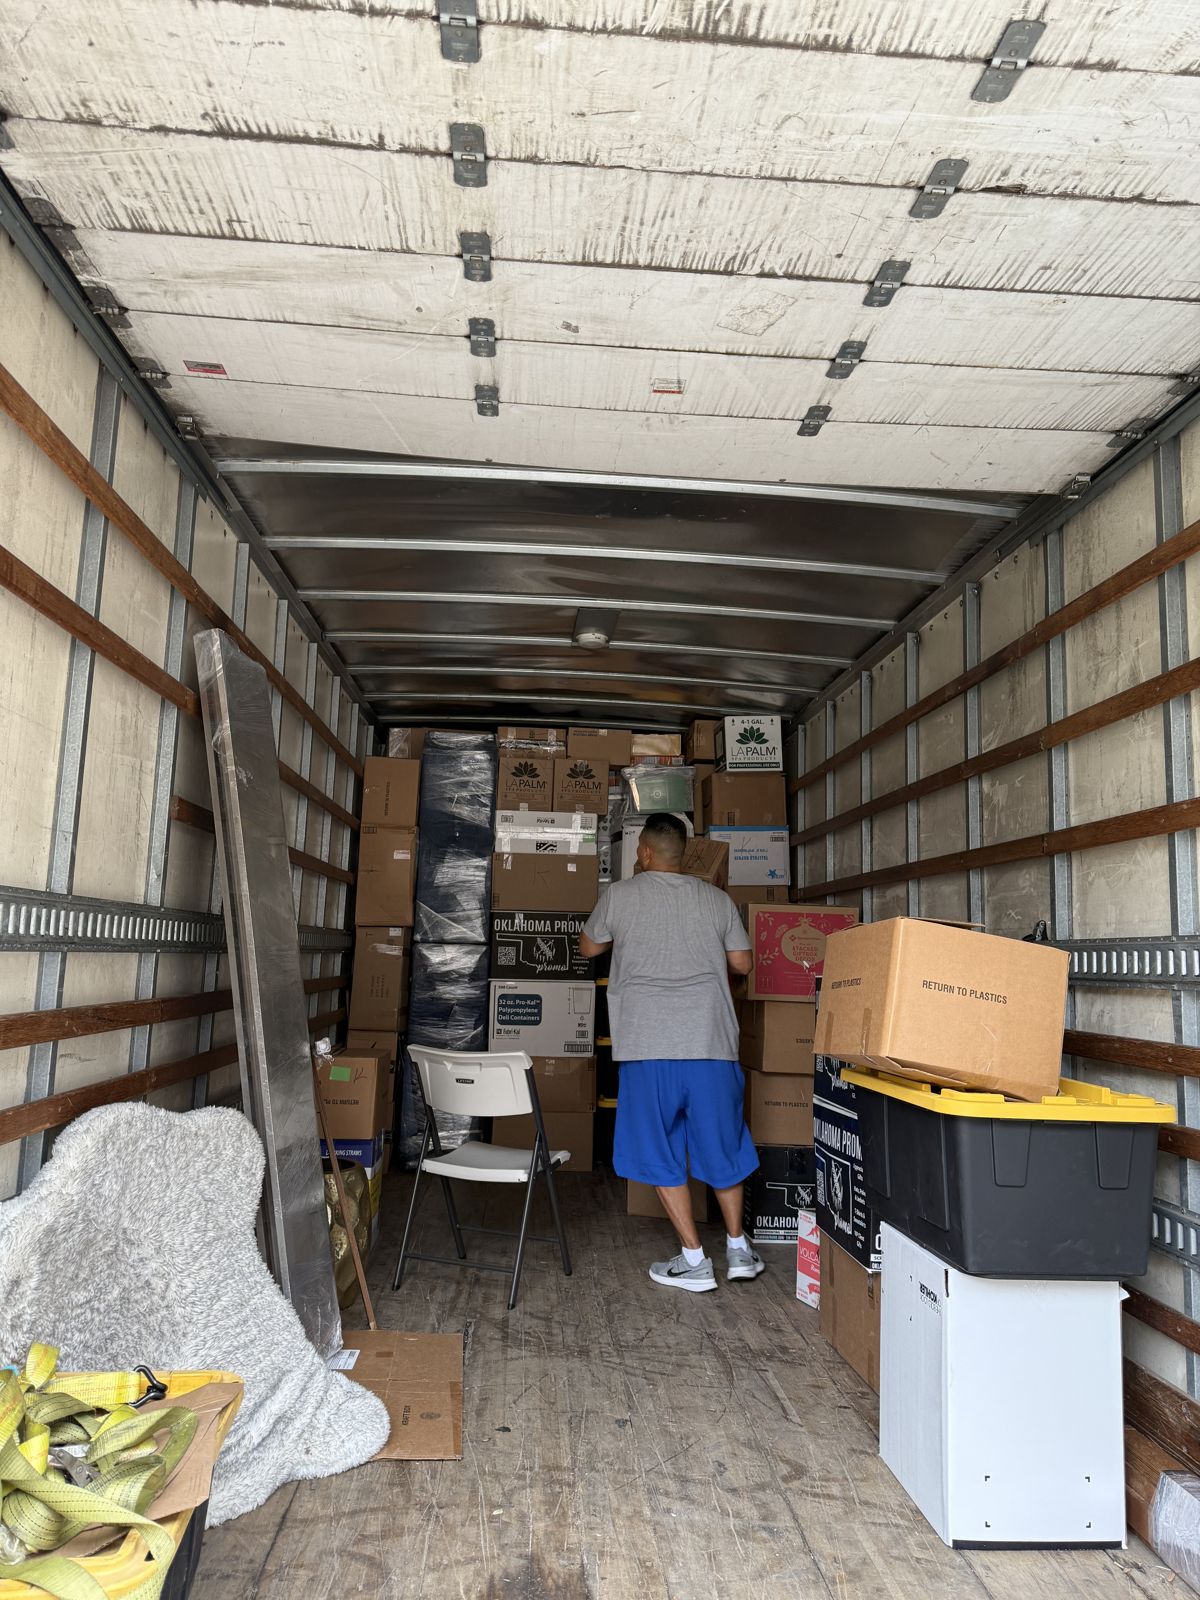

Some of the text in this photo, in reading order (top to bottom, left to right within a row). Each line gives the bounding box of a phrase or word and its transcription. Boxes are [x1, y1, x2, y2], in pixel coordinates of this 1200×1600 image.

[494, 918, 585, 933] OKLAHOMA PROM
[536, 962, 567, 974] promo
[922, 979, 1008, 1005] RETURN TO PLASTICS
[346, 1149, 362, 1157] STRAWS
[841, 1130, 863, 1161] PROM
[756, 1215, 799, 1228] OKLAHOM
[800, 1247, 820, 1262] VOLCA
[919, 1280, 938, 1305] KOHLER
